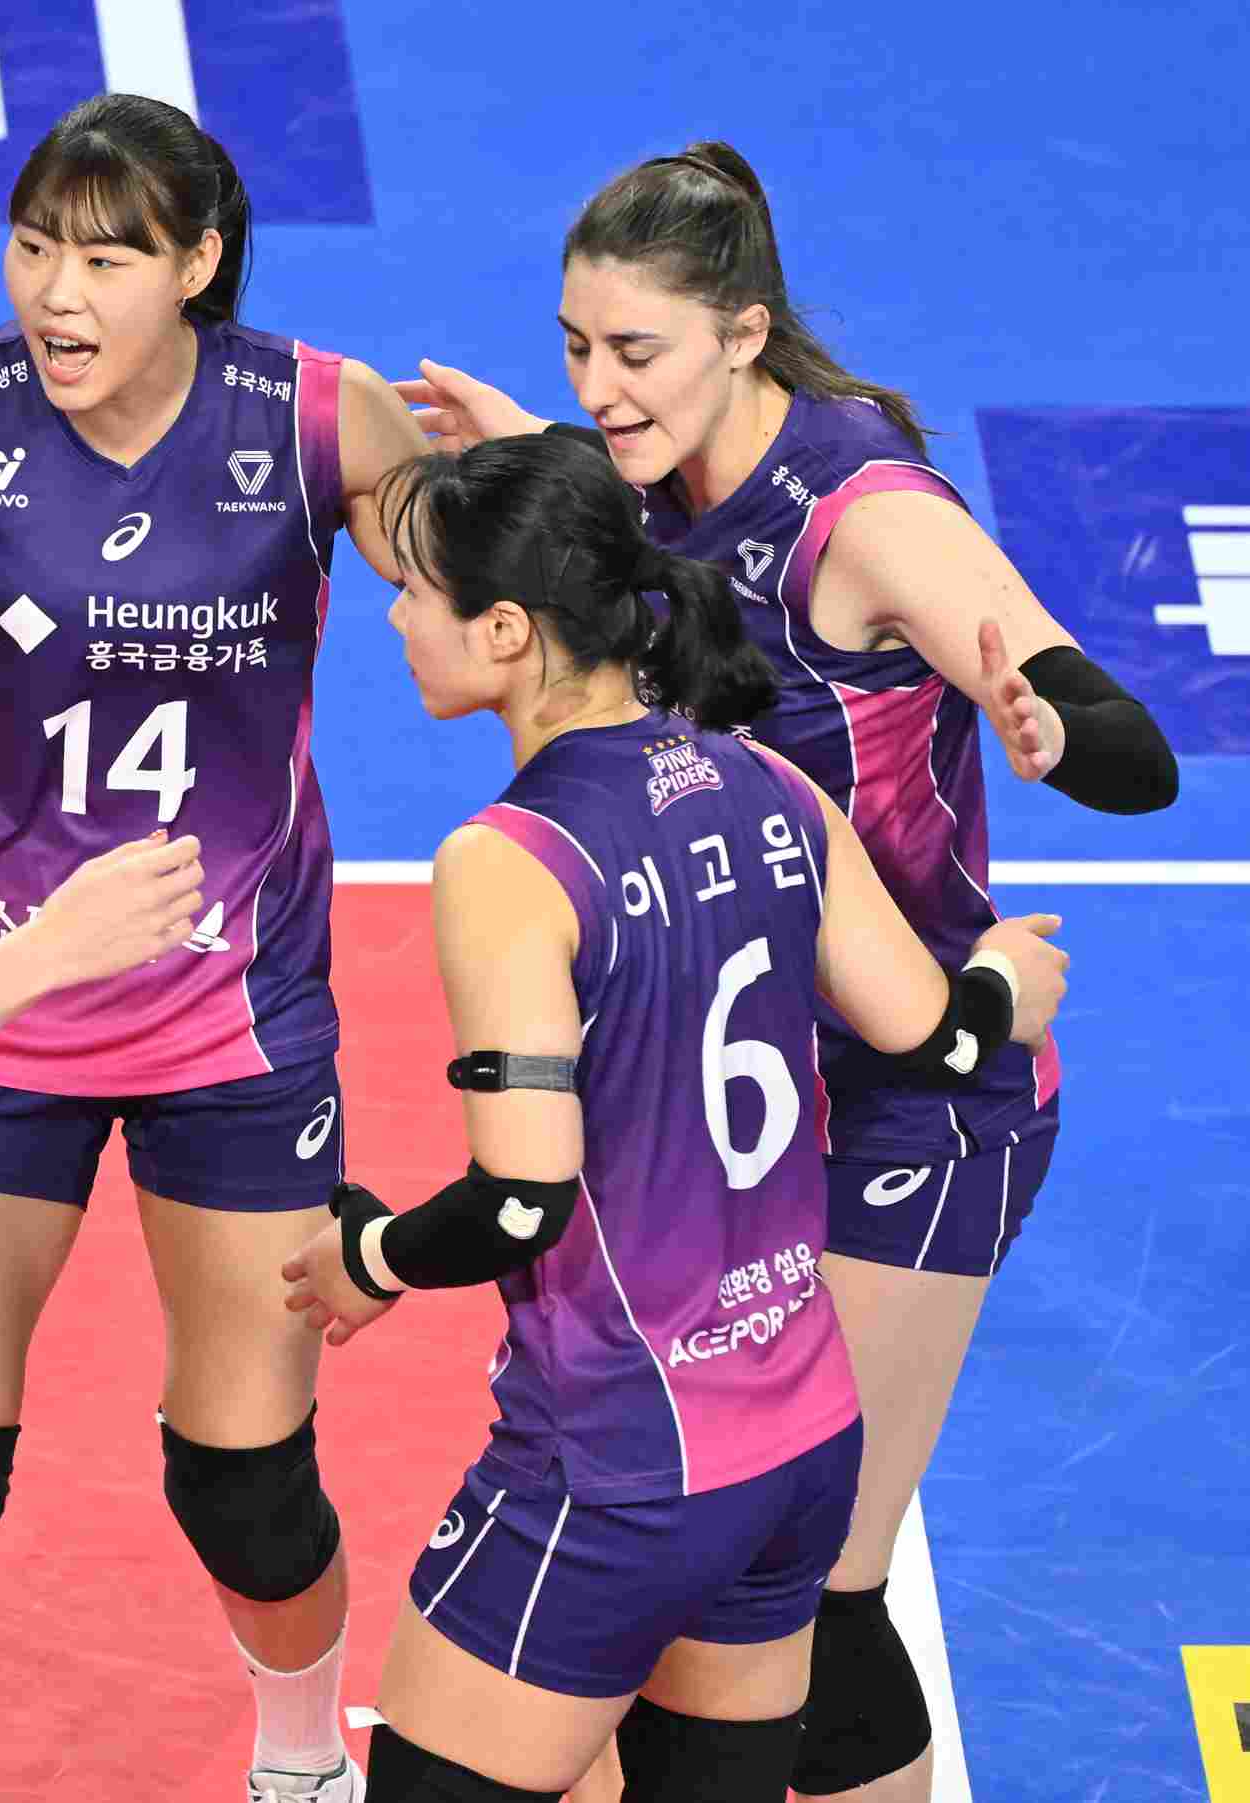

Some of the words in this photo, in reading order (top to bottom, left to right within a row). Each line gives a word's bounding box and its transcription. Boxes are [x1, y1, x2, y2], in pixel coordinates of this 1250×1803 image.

[221, 363, 292, 402] 흥국화재
[215, 501, 287, 513] TAEKWANG
[87, 592, 279, 640] Heungkuk
[85, 637, 269, 673] 흥국금융가족
[42, 700, 197, 823] 14
[650, 760, 720, 810] SPIDERS
[652, 746, 700, 777] PINK
[621, 813, 807, 928] 이고은
[702, 936, 801, 1190] 6
[773, 1242, 817, 1285] 섬유
[667, 1300, 802, 1369] ACEPOR
